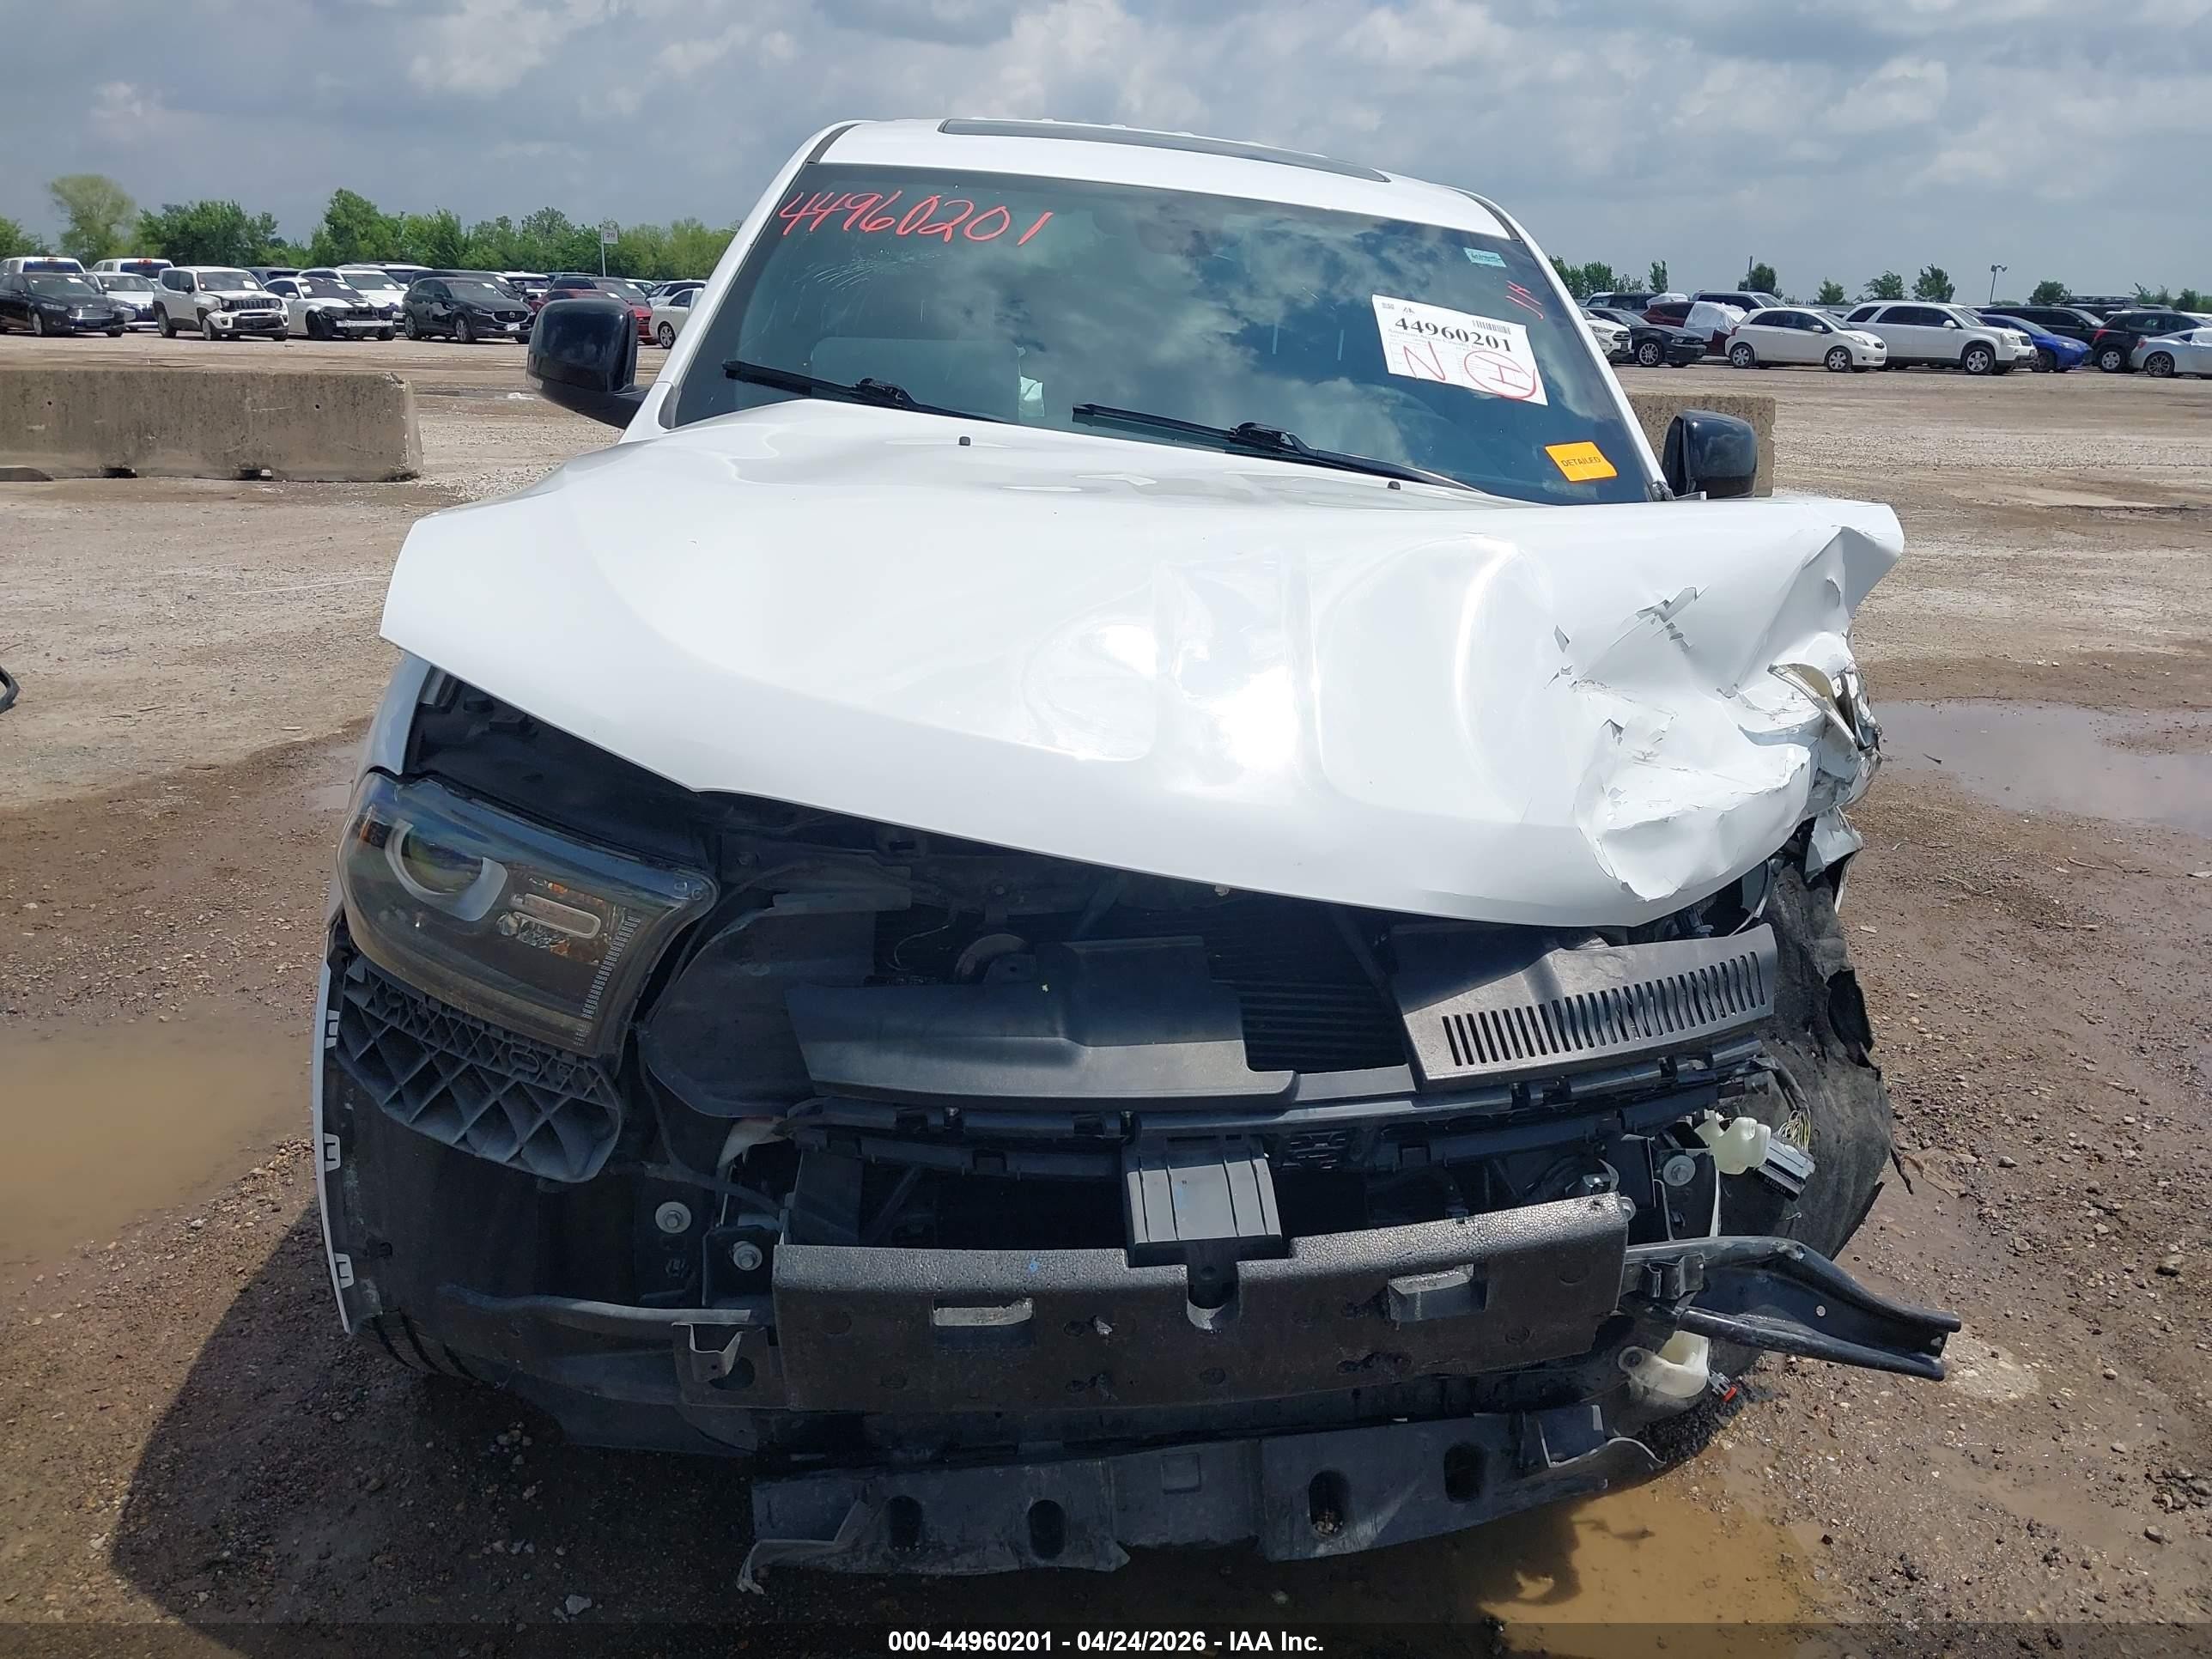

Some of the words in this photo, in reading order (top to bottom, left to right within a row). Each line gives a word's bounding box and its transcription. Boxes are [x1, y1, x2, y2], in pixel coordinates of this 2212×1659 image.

[779, 191, 1054, 246] 44960201
[1395, 318, 1511, 352] 44960201
[1560, 456, 1601, 467] DETAILED
